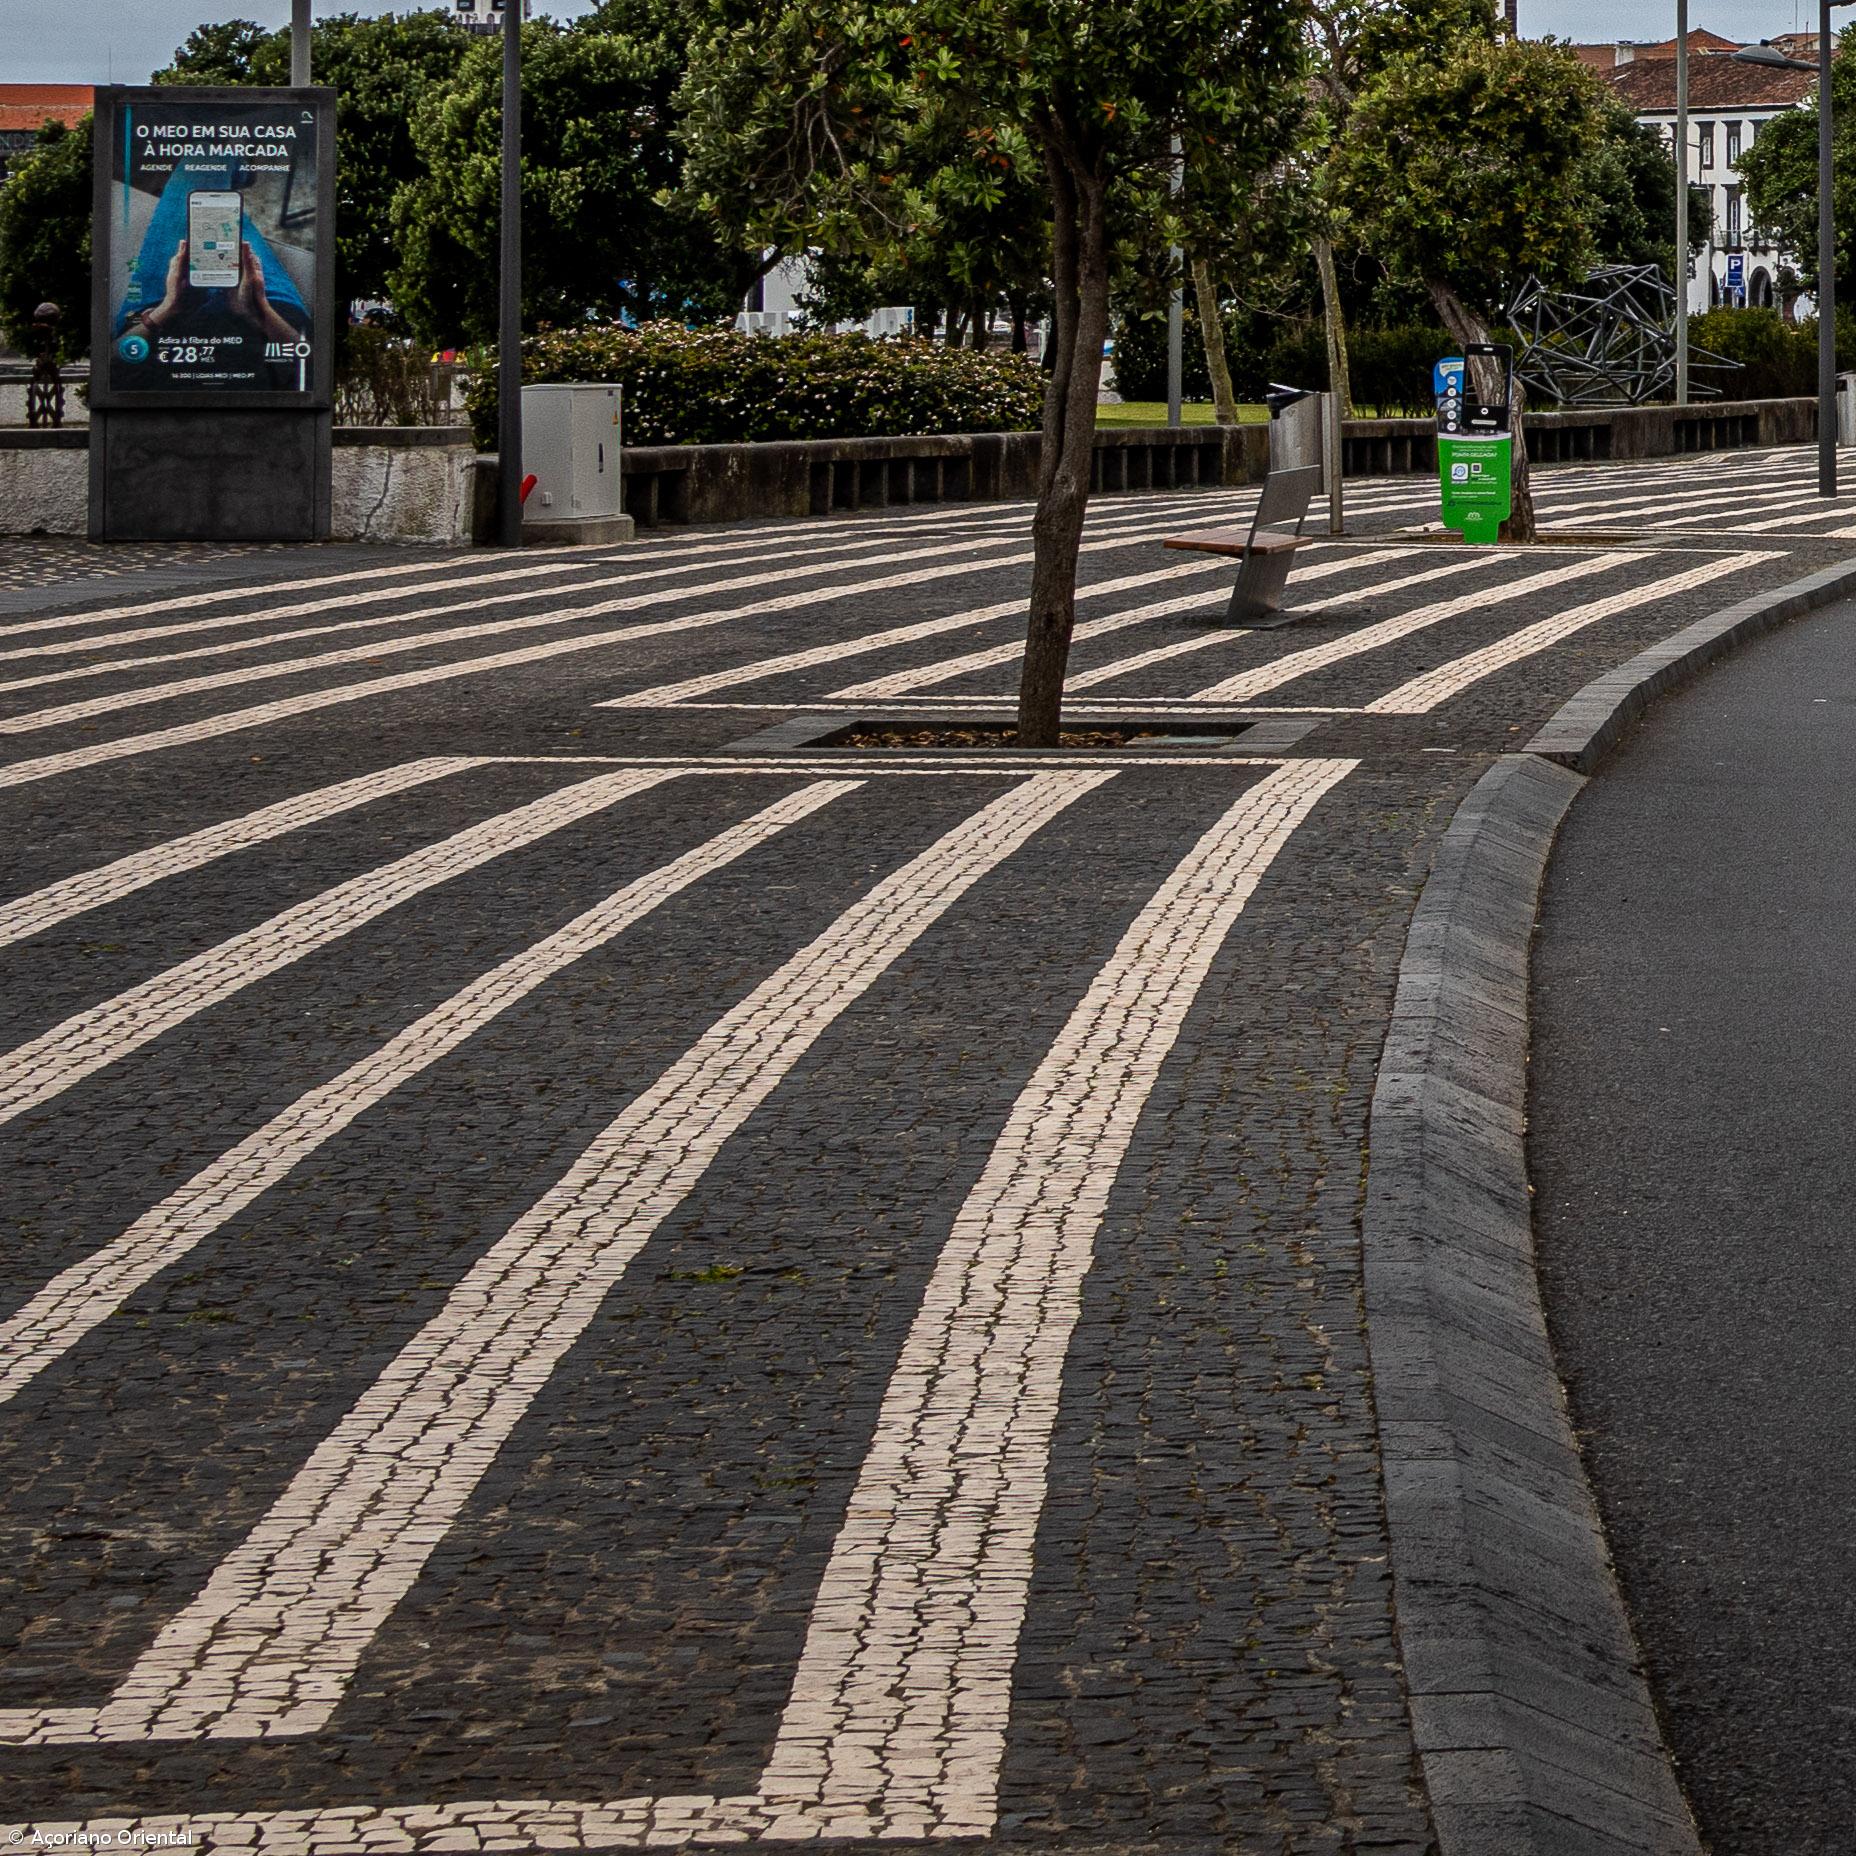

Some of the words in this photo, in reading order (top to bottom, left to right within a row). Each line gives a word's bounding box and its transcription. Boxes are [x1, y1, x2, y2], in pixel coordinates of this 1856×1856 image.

[136, 125, 149, 138] O
[153, 125, 188, 138] MEO
[192, 125, 215, 138] EM
[219, 125, 251, 138] SUA
[254, 125, 297, 138] CASA
[144, 140, 155, 157] À
[160, 143, 205, 157] HORA
[209, 143, 289, 157] MARCADA
[140, 164, 173, 172] AGENDE
[184, 164, 227, 172] REAGENDE
[239, 164, 291, 172] ACOMPANHE
[1730, 259, 1742, 270] P
[129, 344, 138, 355] 5
